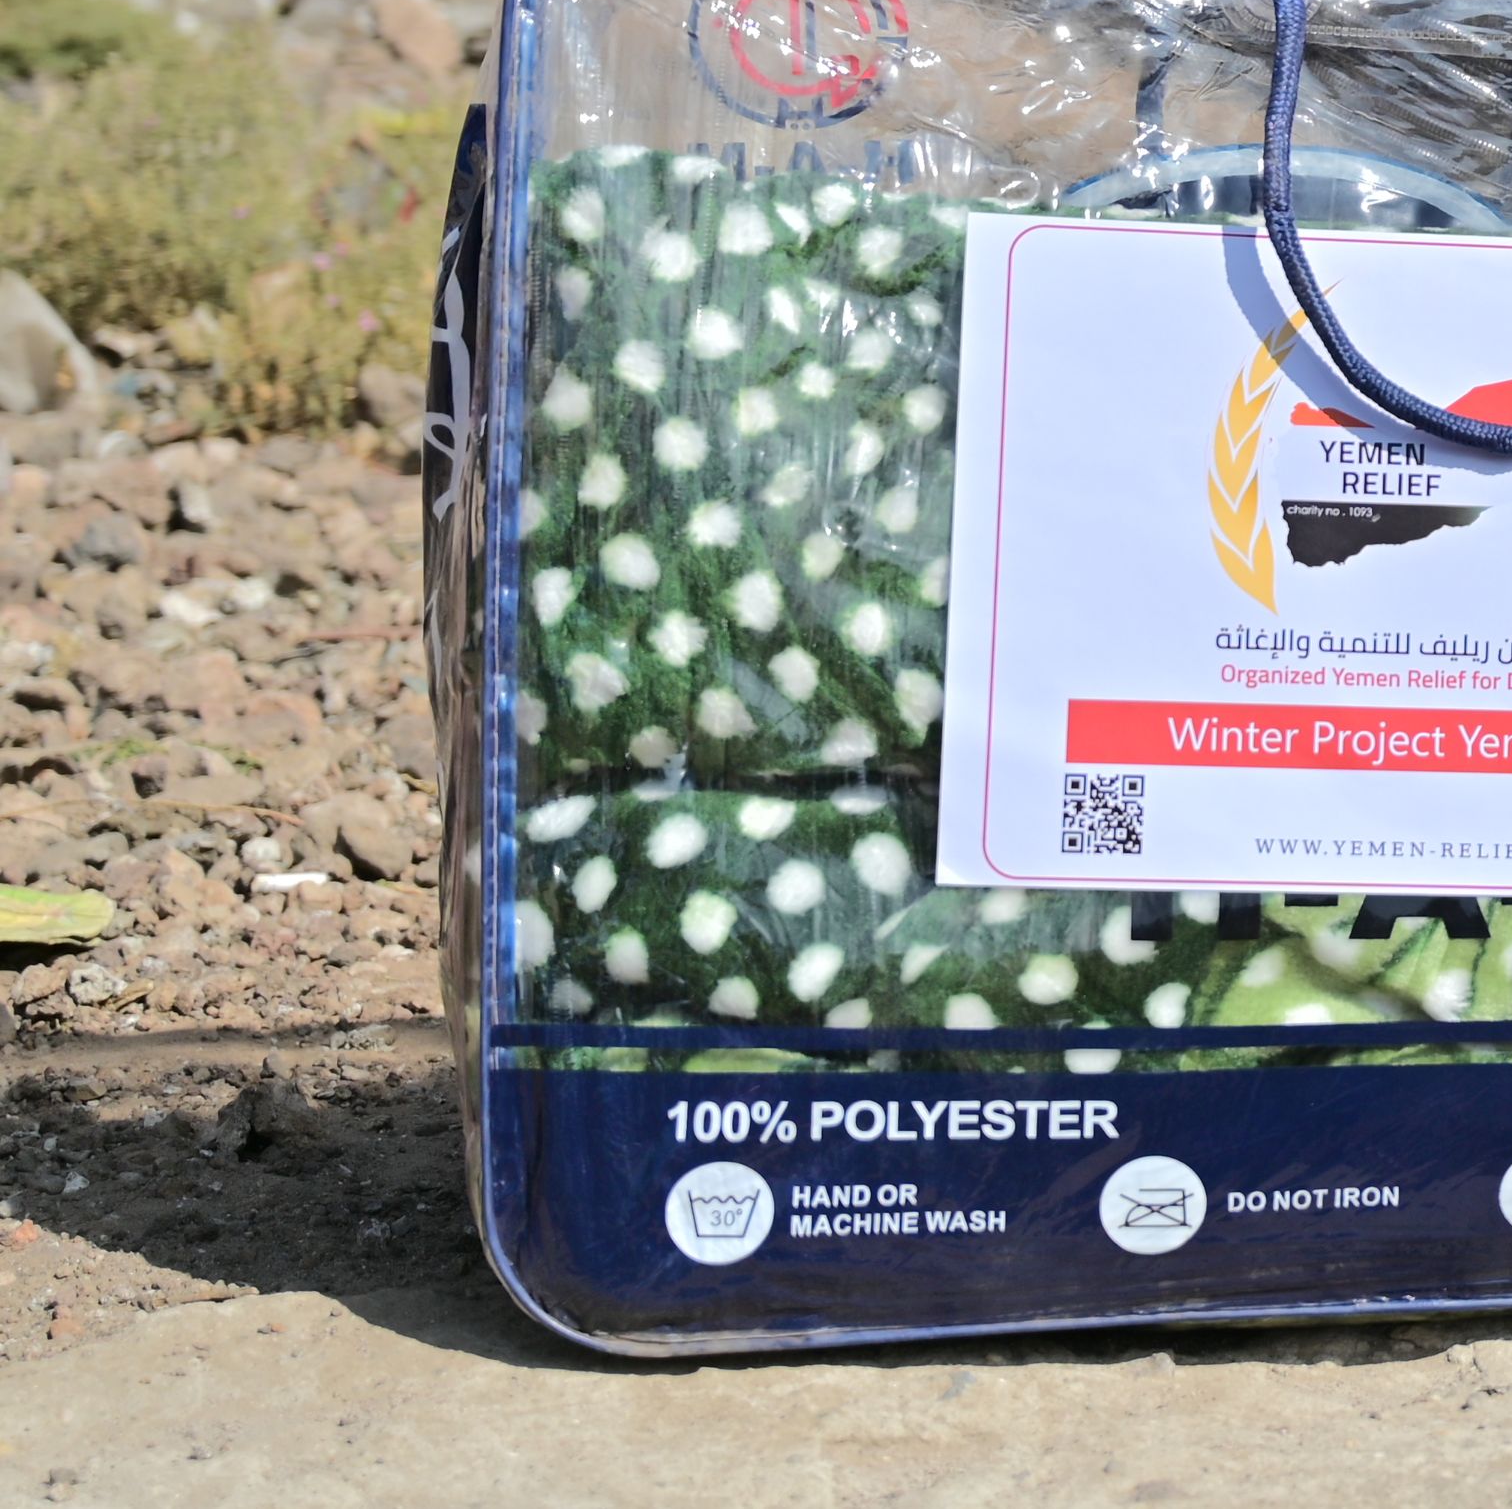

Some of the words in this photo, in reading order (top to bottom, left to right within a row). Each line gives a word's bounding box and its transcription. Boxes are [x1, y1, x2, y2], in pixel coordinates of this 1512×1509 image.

[1319, 440, 1425, 466] YEMEN
[1342, 471, 1441, 496] RELIEF
[1286, 505, 1324, 517] charity
[1349, 506, 1373, 518] 1093
[1215, 624, 1310, 660] والإغاثة
[1318, 630, 1411, 659] للتنمية
[1419, 633, 1490, 665] ريليف
[1221, 663, 1326, 689] Organized
[1332, 667, 1400, 688] Yemen
[1408, 669, 1466, 689] Relief
[1471, 671, 1501, 690] for
[1168, 716, 1299, 755] Winter
[1312, 719, 1446, 766] Project
[667, 1100, 798, 1144] 100%
[810, 1099, 1119, 1142] POLYESTER
[792, 1184, 871, 1209] HAND
[877, 1183, 918, 1207] OR
[1227, 1191, 1267, 1213] DO
[1272, 1188, 1329, 1212] NOT
[1333, 1186, 1400, 1209] IRON
[790, 1211, 919, 1238] MACHINE
[924, 1210, 1006, 1234] WASH
